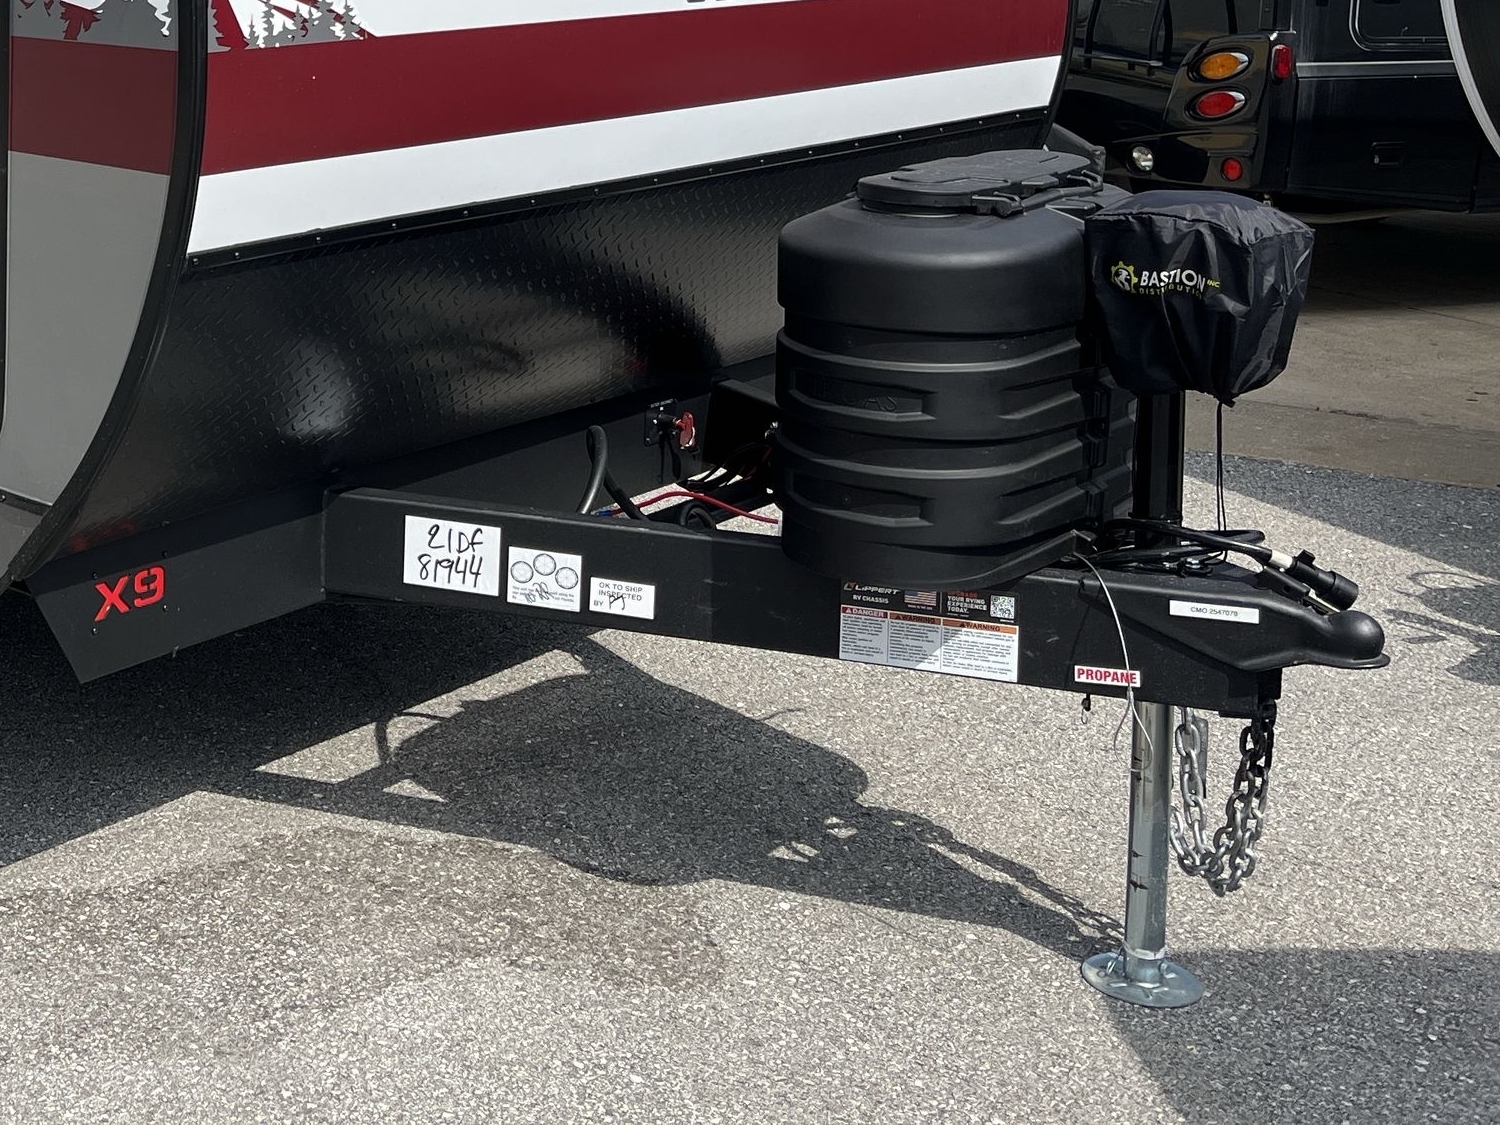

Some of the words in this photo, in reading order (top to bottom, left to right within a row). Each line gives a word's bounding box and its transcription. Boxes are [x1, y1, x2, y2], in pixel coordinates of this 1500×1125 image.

[1140, 268, 1206, 293] BASTION
[1207, 278, 1221, 288] INC
[599, 581, 611, 589] OK
[612, 583, 623, 591] TO
[625, 585, 643, 593] SHIP
[855, 584, 901, 595] LIPPERT
[94, 565, 165, 622] X9
[852, 607, 885, 618] DANGER
[966, 622, 1001, 632] WARNING
[1077, 668, 1137, 685] PROPANE
